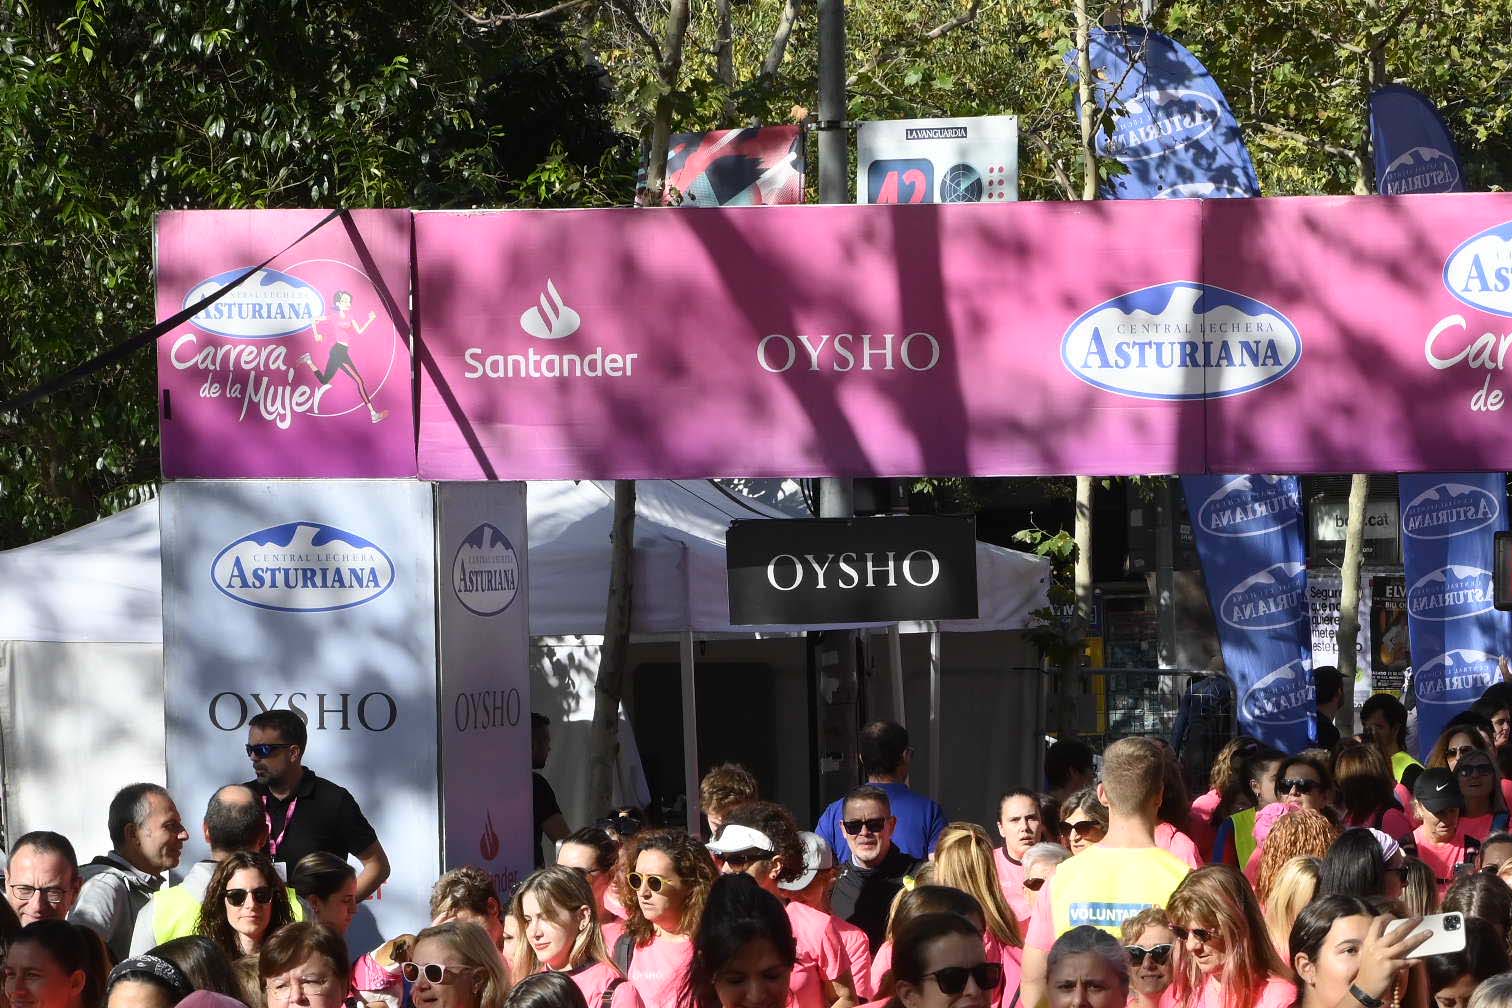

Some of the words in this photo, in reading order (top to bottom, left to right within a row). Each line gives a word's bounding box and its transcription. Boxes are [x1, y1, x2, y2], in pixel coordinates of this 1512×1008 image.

[917, 128, 967, 138] VANGUARDIA
[192, 292, 313, 321] ASTURIANA
[1117, 323, 1192, 335] CENTRAL
[1200, 321, 1274, 334] LECHERA
[170, 333, 289, 371] Carrera
[464, 347, 639, 380] Santander
[756, 332, 940, 374] OYSHO
[1081, 326, 1283, 369] ASTURIANA
[200, 374, 222, 399] de
[226, 372, 242, 399] la
[239, 367, 333, 430] Mujer
[1470, 373, 1505, 412] de
[226, 555, 382, 590] ASTURIANA
[252, 552, 311, 563] CENTRAL
[316, 552, 376, 562] LECHERA
[457, 557, 516, 593] ASTURIANA
[766, 549, 941, 592] OYSHO
[1311, 603, 1328, 613] que
[1312, 642, 1331, 652] este
[208, 691, 398, 732] OYSHO
[454, 687, 521, 733] OYSHO
